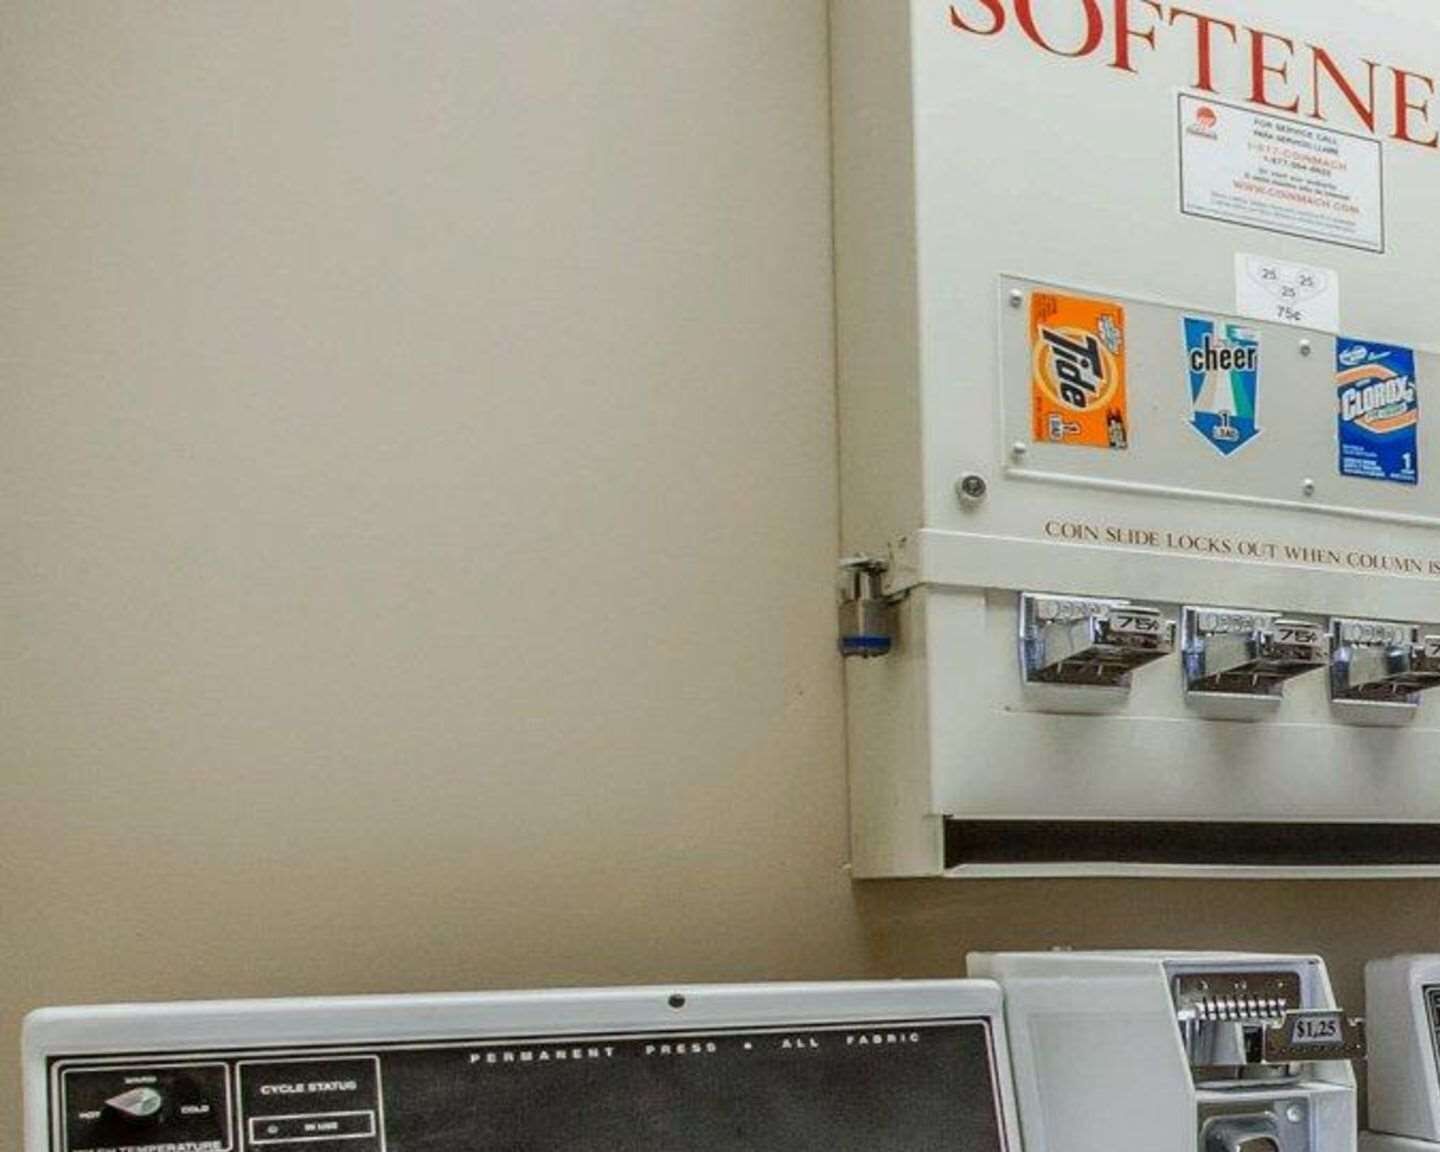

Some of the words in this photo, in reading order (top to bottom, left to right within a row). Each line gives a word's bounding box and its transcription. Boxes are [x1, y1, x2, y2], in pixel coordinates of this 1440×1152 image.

[1261, 268, 1277, 280] 25
[1299, 274, 1313, 287] 25
[1281, 285, 1296, 297] 25
[1277, 304, 1302, 321] 75¢
[1191, 334, 1256, 371] cheer
[1042, 328, 1104, 409] Tide
[1222, 411, 1229, 428] 1
[1045, 519, 1099, 541] COIN
[1105, 526, 1160, 548] SLIDE
[1166, 532, 1232, 555] LOCKS
[1238, 541, 1277, 559] OUT
[1284, 546, 1341, 565] WHEN
[1347, 551, 1423, 574] COLUMN
[1296, 1020, 1337, 1038] $1.25
[469, 1046, 616, 1064] PERMANENT
[645, 1042, 717, 1055] PRESS
[781, 1036, 821, 1049] ALL
[845, 1031, 921, 1046] FABRIC
[260, 1083, 304, 1096] CYCLE
[308, 1080, 358, 1093] STATUS
